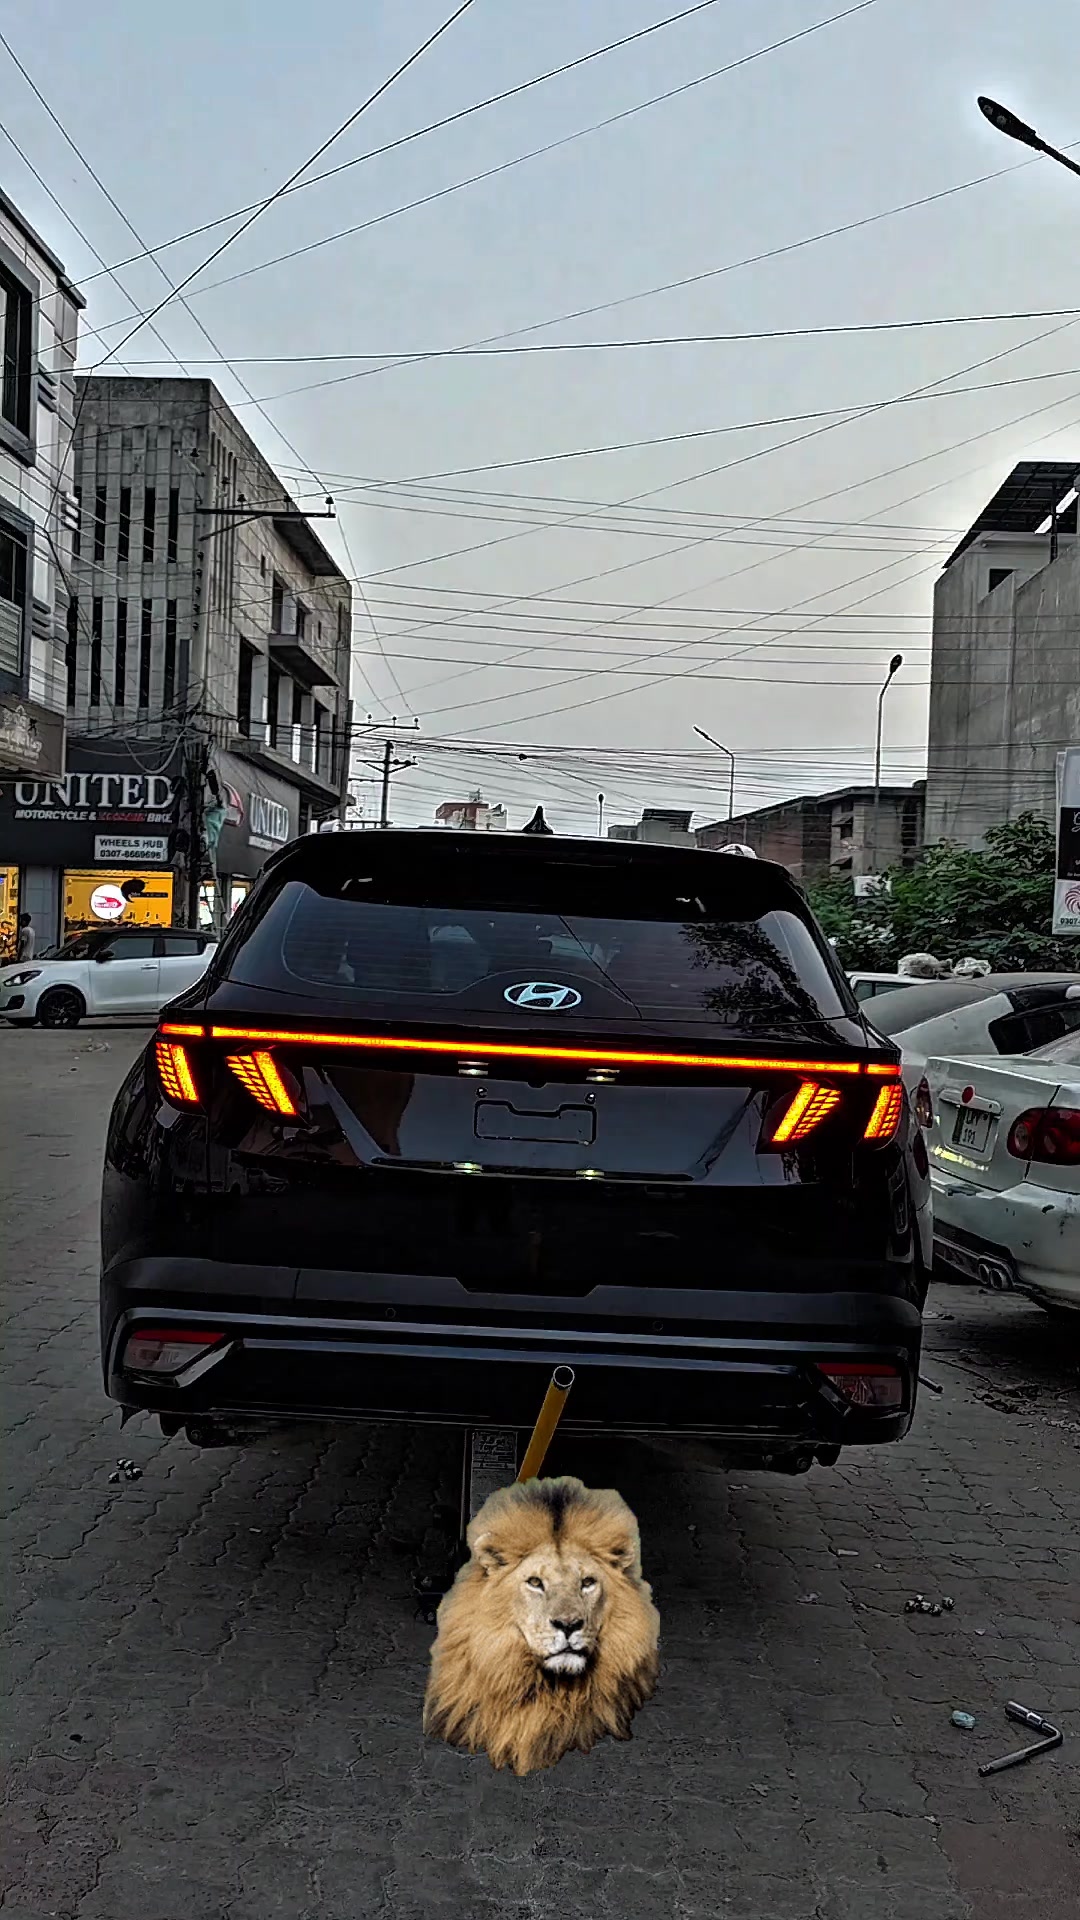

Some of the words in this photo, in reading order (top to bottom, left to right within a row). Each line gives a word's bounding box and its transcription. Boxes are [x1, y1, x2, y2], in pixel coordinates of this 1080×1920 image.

[14, 773, 175, 809] UNITED
[15, 809, 89, 821] MOTORCYCLE
[89, 811, 97, 821] &
[147, 811, 173, 823] BIKE
[249, 791, 289, 842] UNITED
[99, 838, 140, 847] WHEELS
[142, 839, 164, 848] HUB
